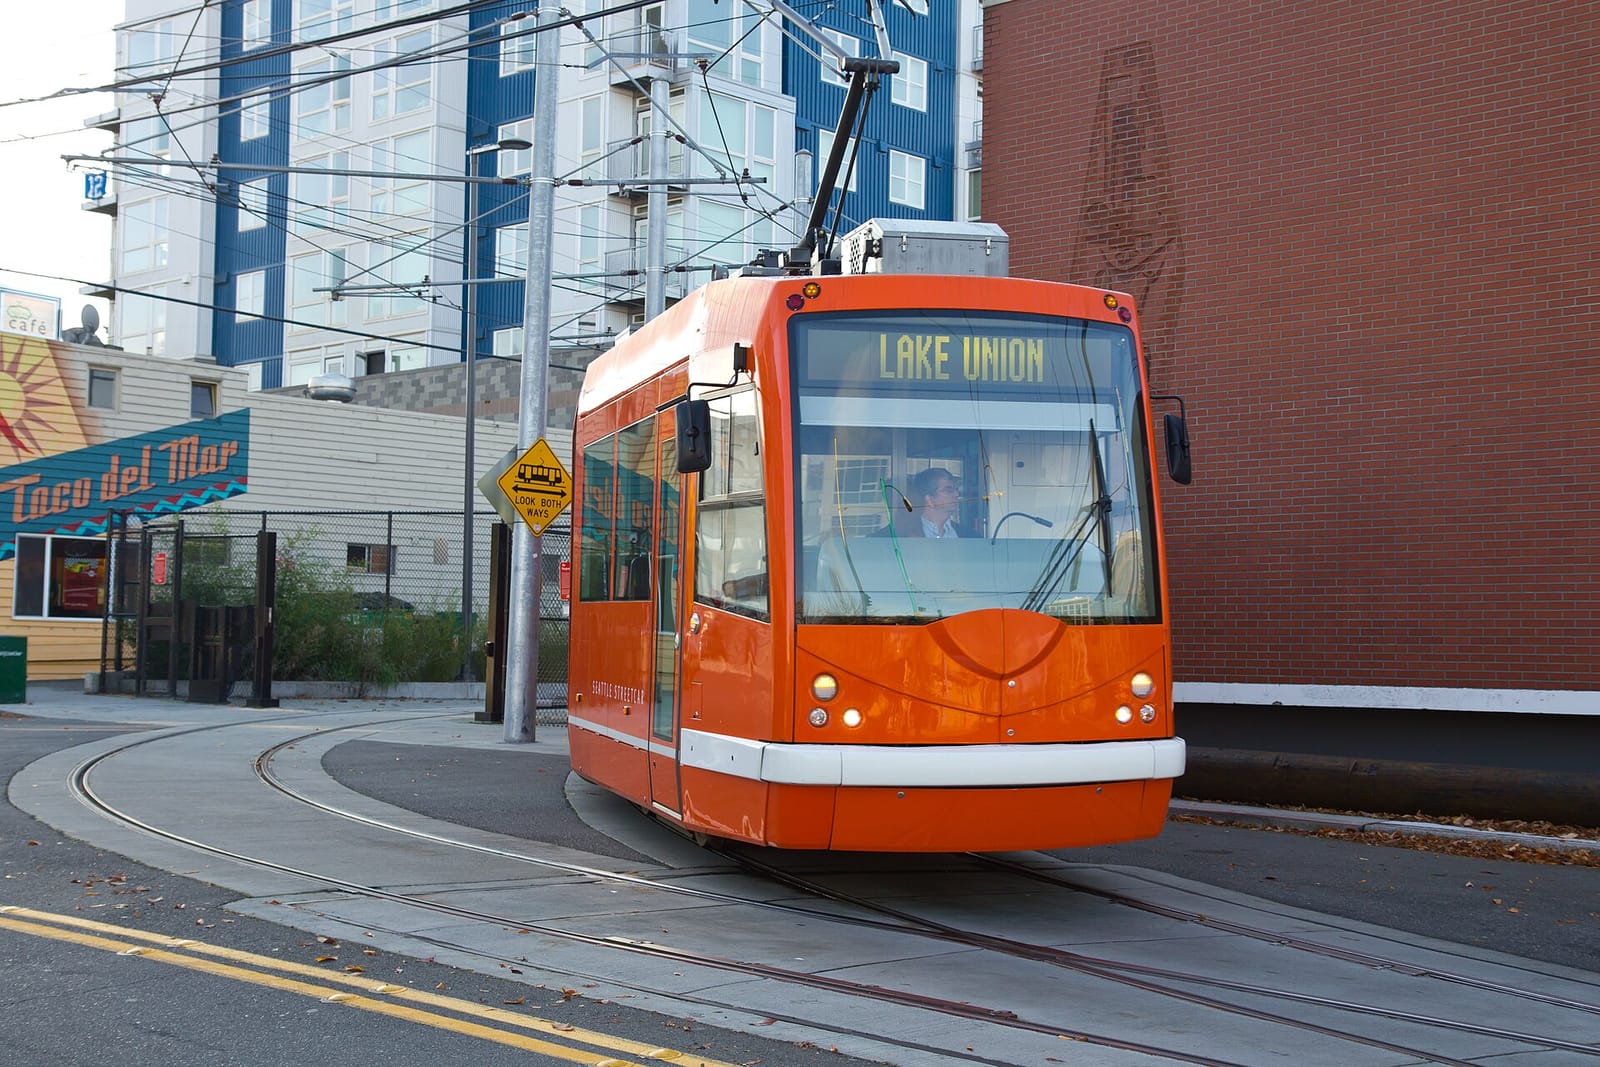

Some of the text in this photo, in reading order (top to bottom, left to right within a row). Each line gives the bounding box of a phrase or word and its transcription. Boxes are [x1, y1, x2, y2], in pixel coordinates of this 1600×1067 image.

[87, 175, 103, 198] 12
[9, 319, 47, 335] café
[879, 333, 1044, 383] LAKE UNION
[0, 434, 239, 523] Taco del Mar
[515, 495, 562, 509] LOOK BOTH
[526, 508, 549, 519] WAYS
[592, 680, 645, 705] SEATTLE STREETCAR
